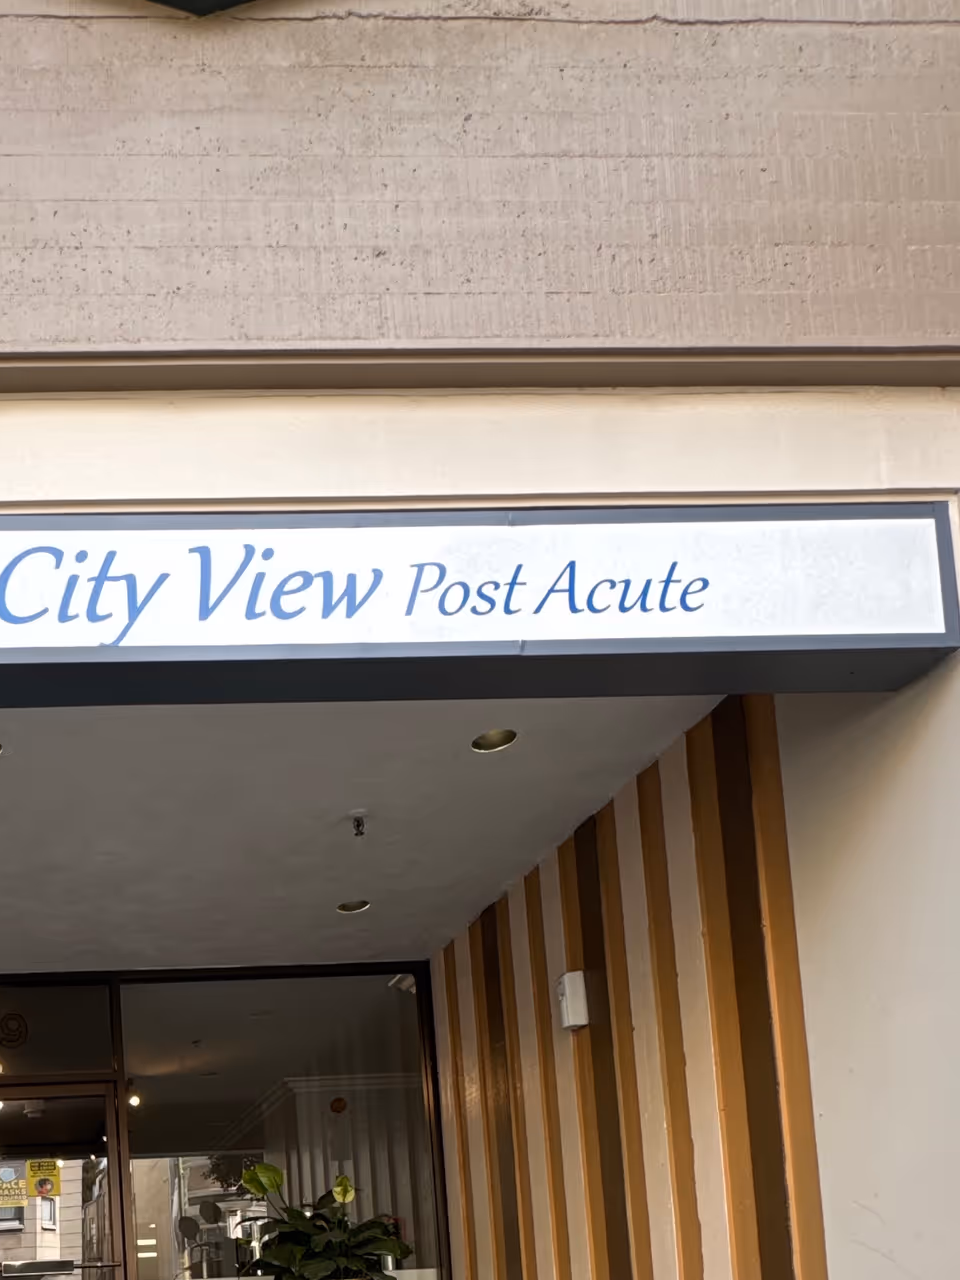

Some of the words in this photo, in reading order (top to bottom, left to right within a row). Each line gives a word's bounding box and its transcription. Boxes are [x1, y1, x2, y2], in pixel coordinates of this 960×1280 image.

[188, 543, 384, 621] View
[404, 562, 527, 617] Post
[533, 559, 710, 615] Acute
